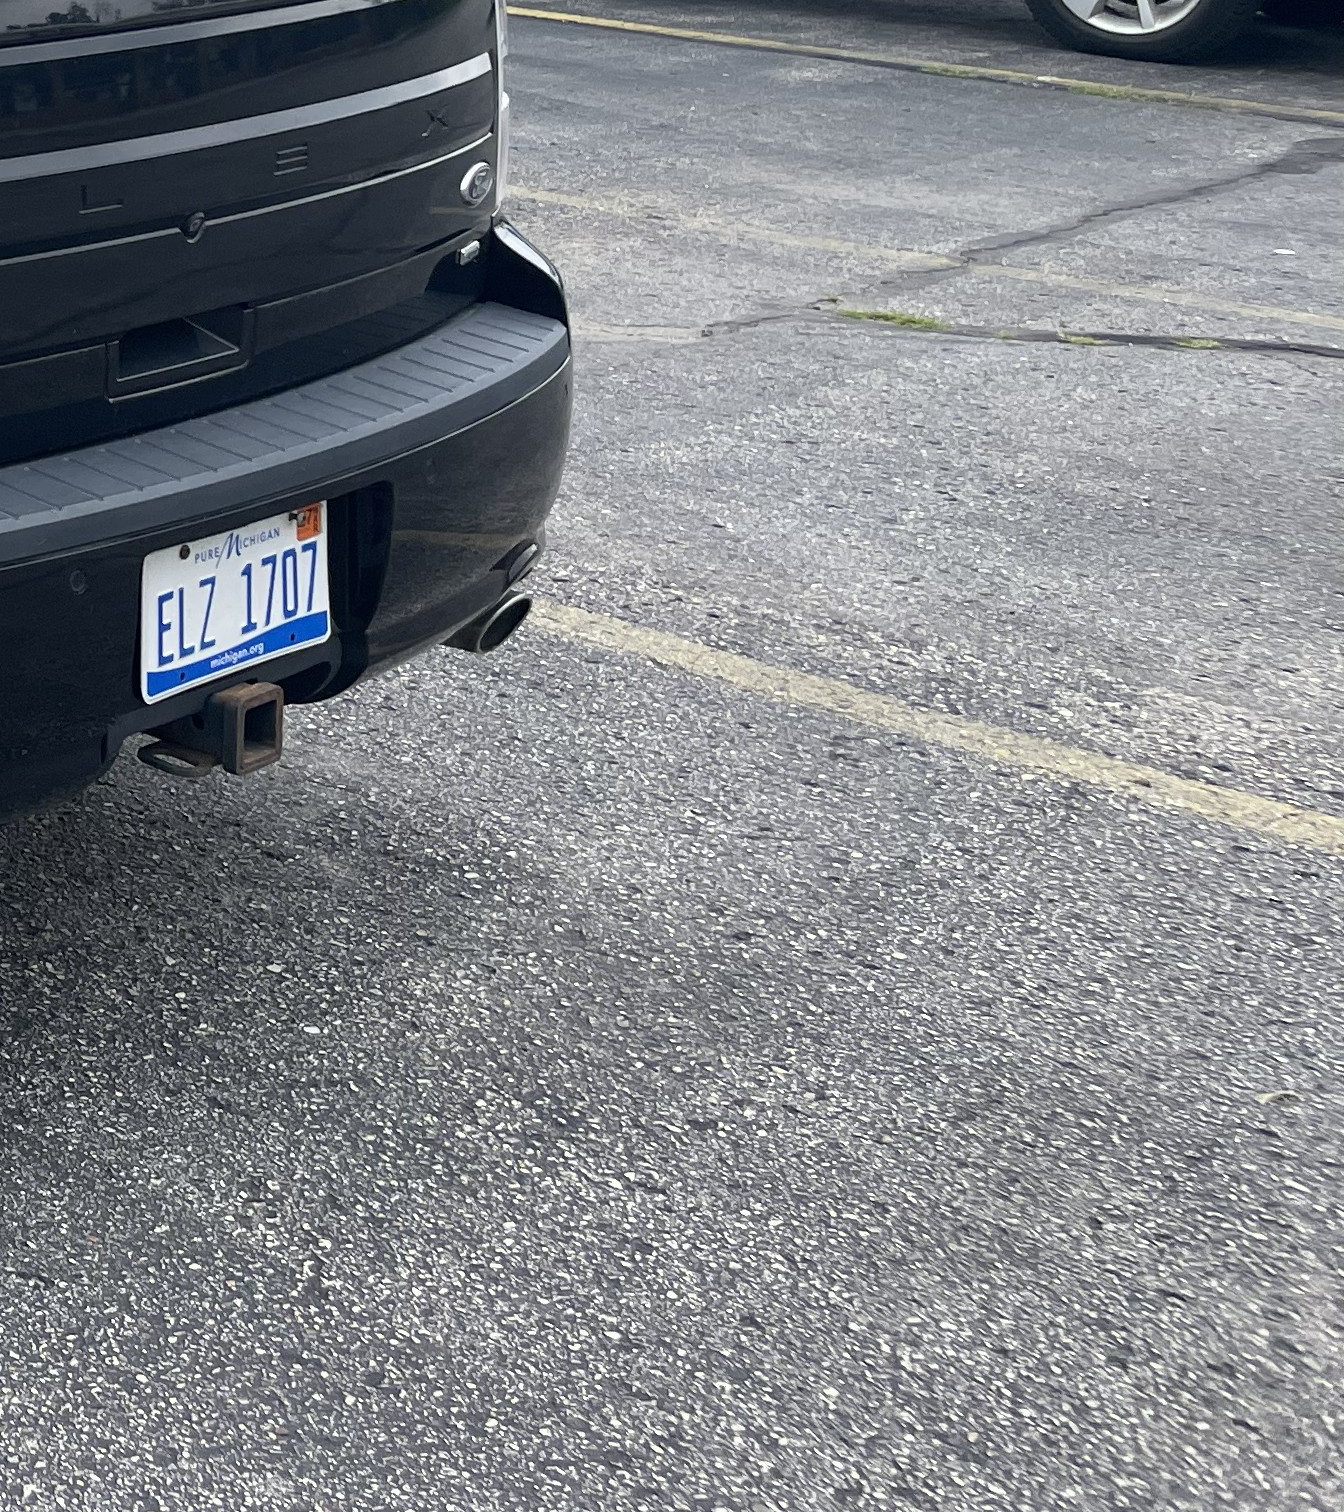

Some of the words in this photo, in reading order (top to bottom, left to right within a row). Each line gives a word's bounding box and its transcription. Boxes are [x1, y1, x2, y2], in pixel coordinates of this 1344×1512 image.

[194, 546, 221, 564] PURE
[157, 575, 217, 668] ELZ
[240, 540, 318, 635] 1707
[210, 642, 264, 669] michigan.org
